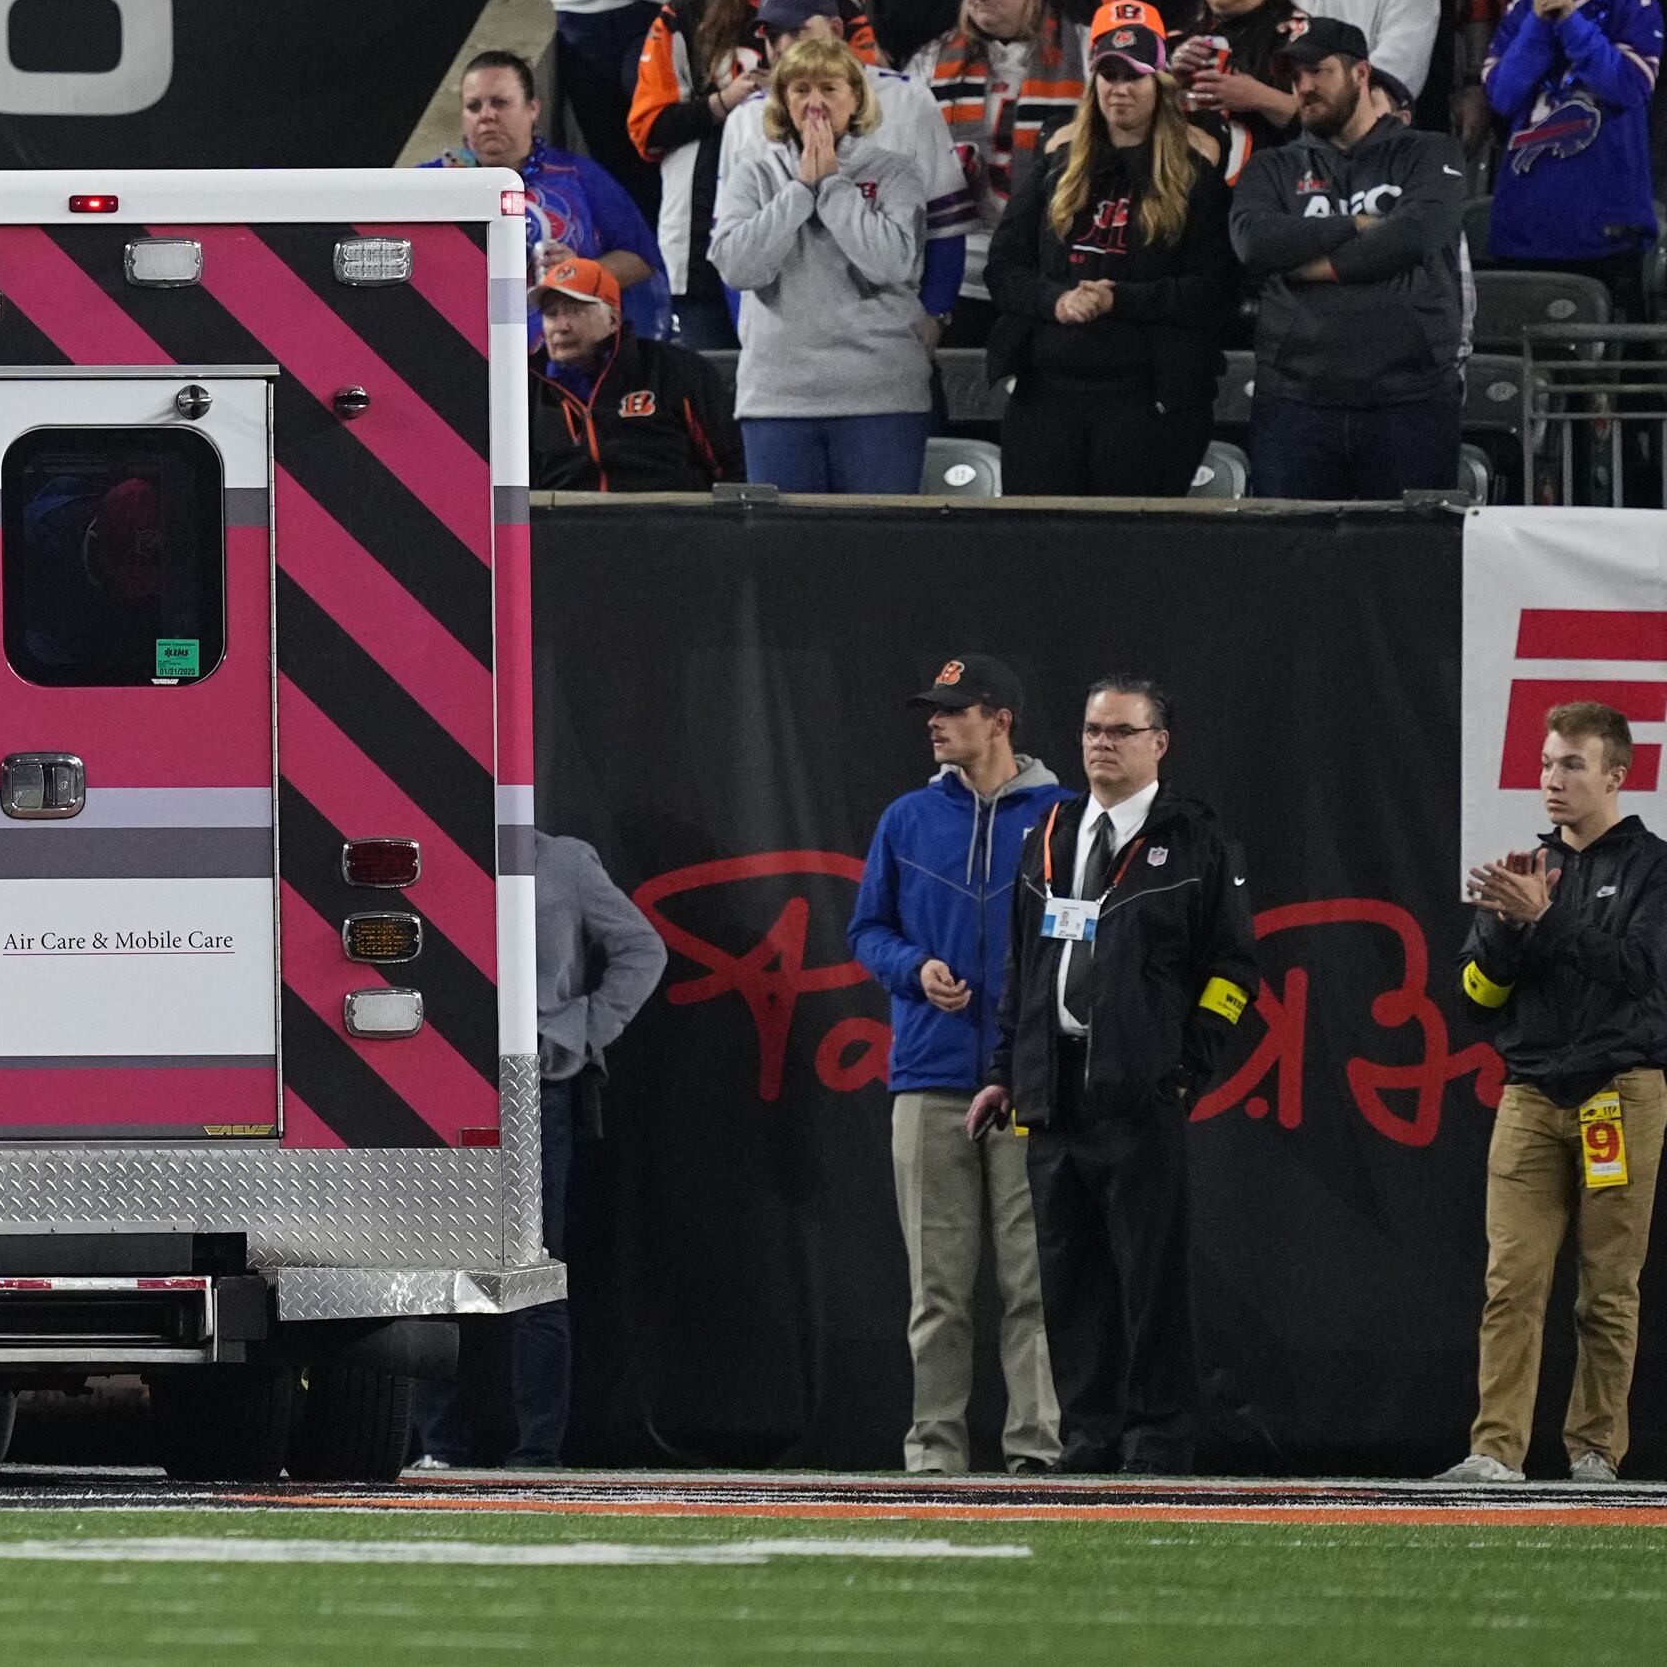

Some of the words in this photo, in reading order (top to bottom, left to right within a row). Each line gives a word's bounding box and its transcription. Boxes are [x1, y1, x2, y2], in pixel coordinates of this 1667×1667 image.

[174, 648, 189, 657] EMS
[4, 931, 35, 951] Air
[41, 931, 87, 951] Care
[92, 932, 107, 950] &
[114, 930, 183, 951] Mobile
[188, 931, 234, 950] Care
[1586, 1122, 1620, 1165] 9
